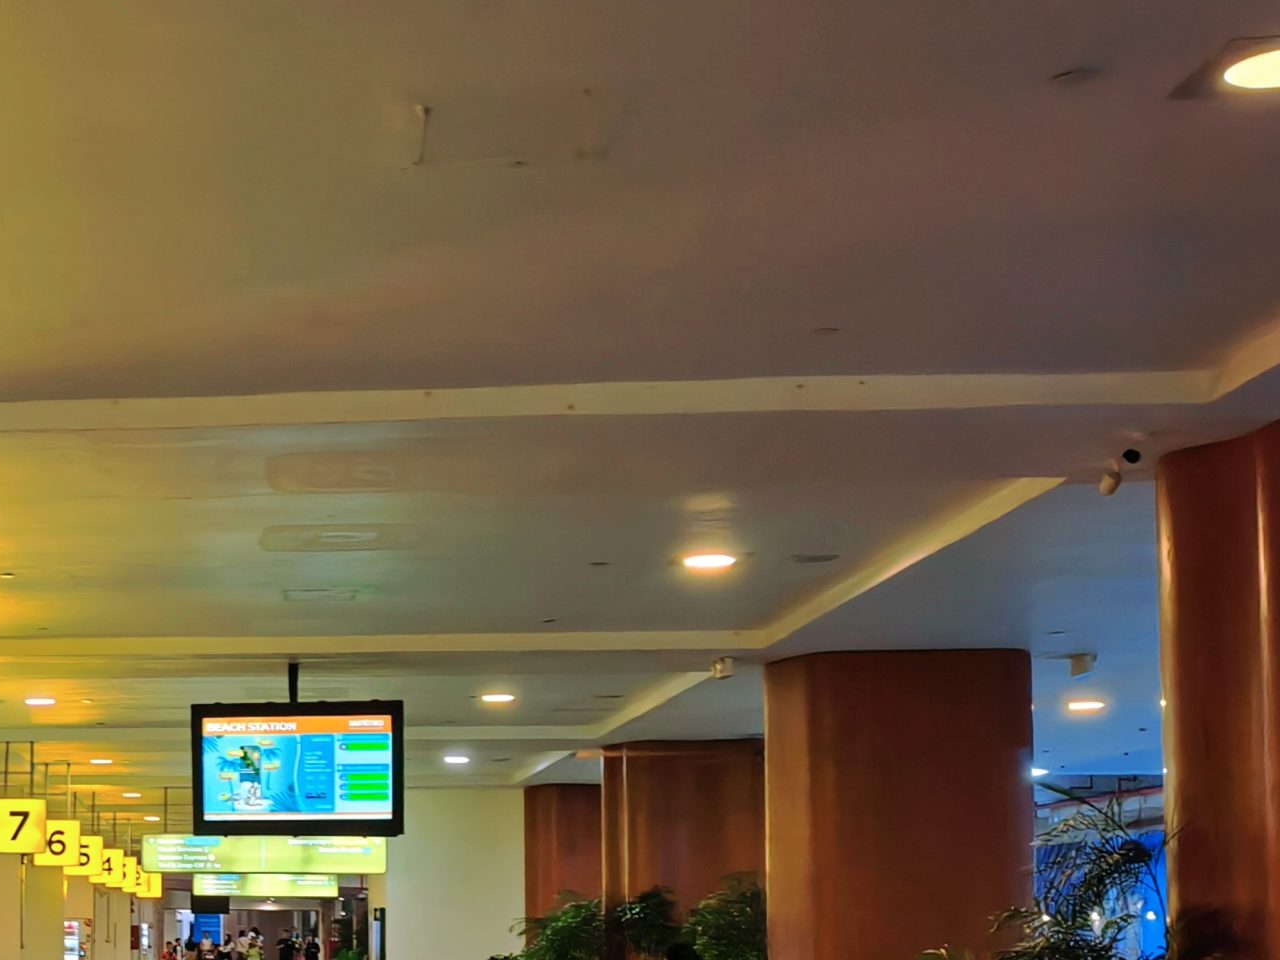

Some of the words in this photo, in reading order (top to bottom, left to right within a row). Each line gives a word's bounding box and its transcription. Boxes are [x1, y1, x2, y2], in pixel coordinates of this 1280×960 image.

[205, 722, 246, 732] BEACH
[247, 721, 297, 731] STATION
[8, 811, 30, 841] 7
[48, 830, 66, 856] 6
[80, 845, 90, 866] 5
[102, 857, 113, 875] 4
